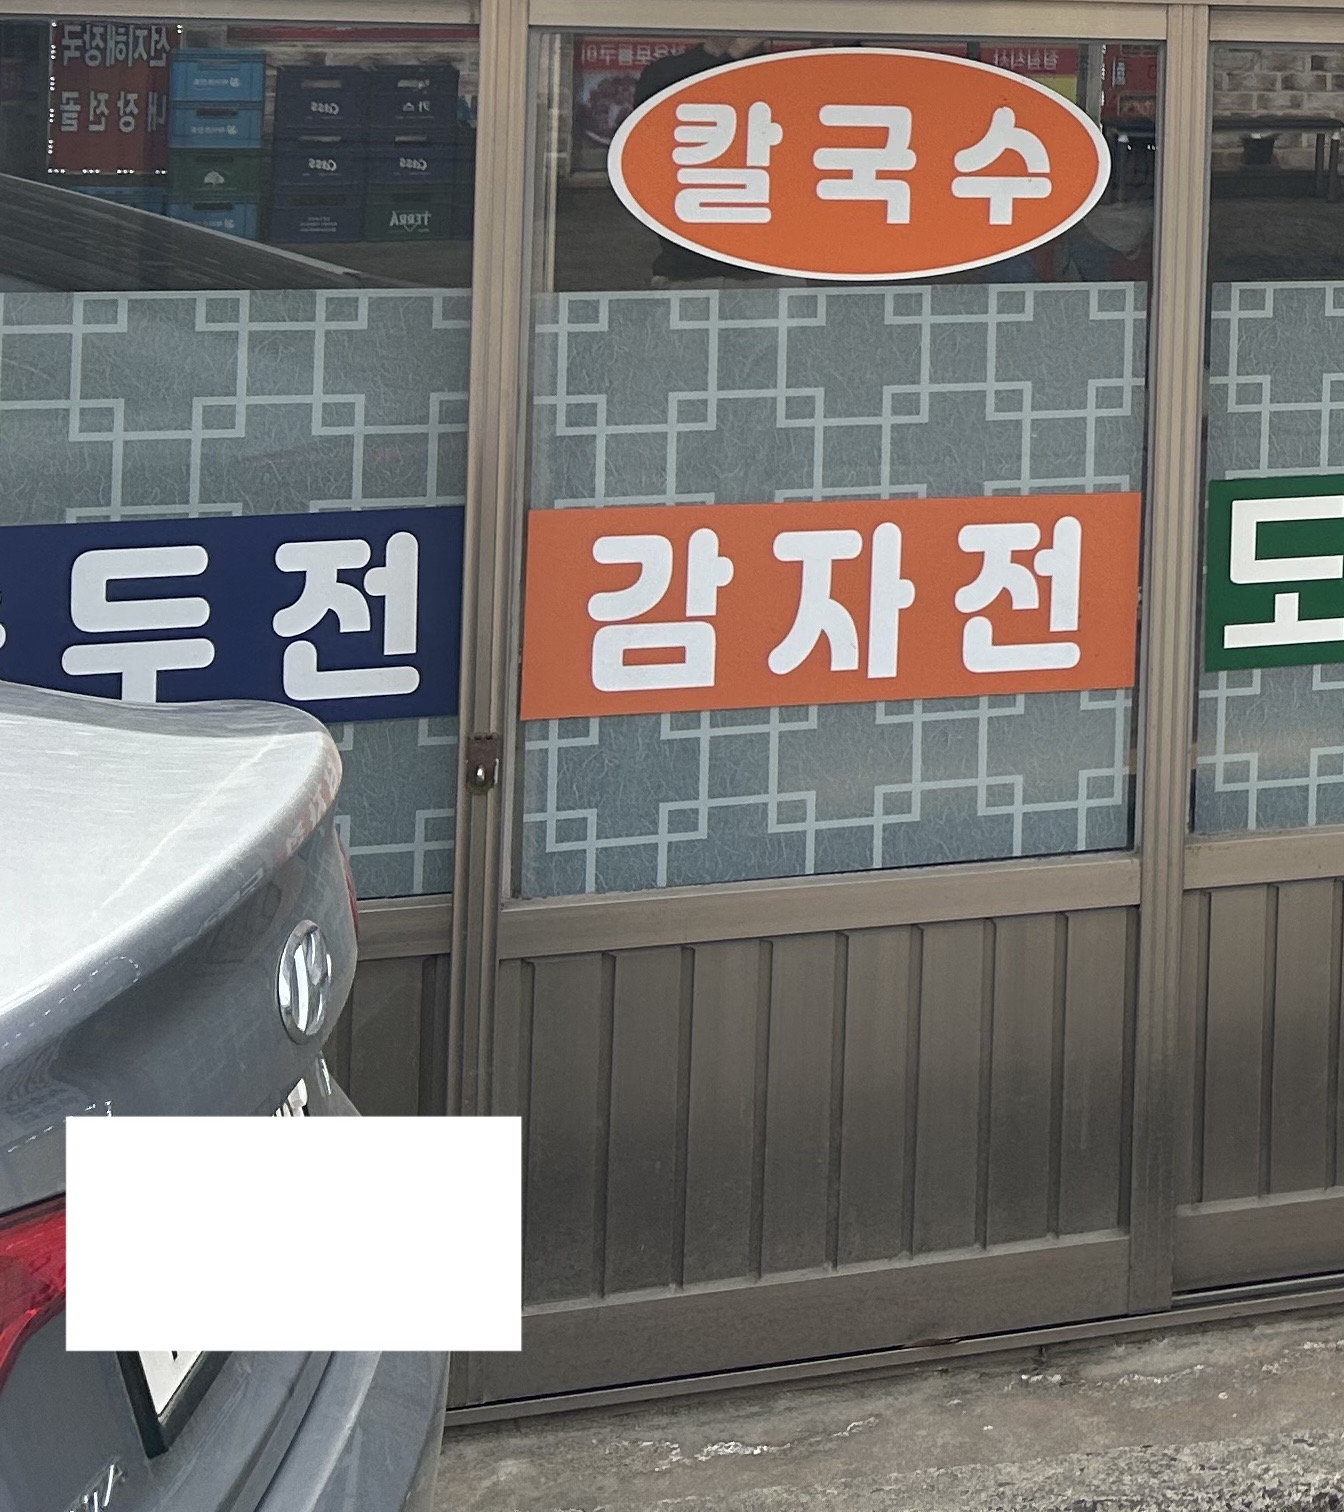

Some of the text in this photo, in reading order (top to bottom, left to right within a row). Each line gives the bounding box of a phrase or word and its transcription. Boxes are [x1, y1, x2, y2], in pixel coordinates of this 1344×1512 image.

[671, 100, 1053, 226] 칼국수
[0, 531, 420, 703] 두전
[586, 515, 1083, 693] 감자전
